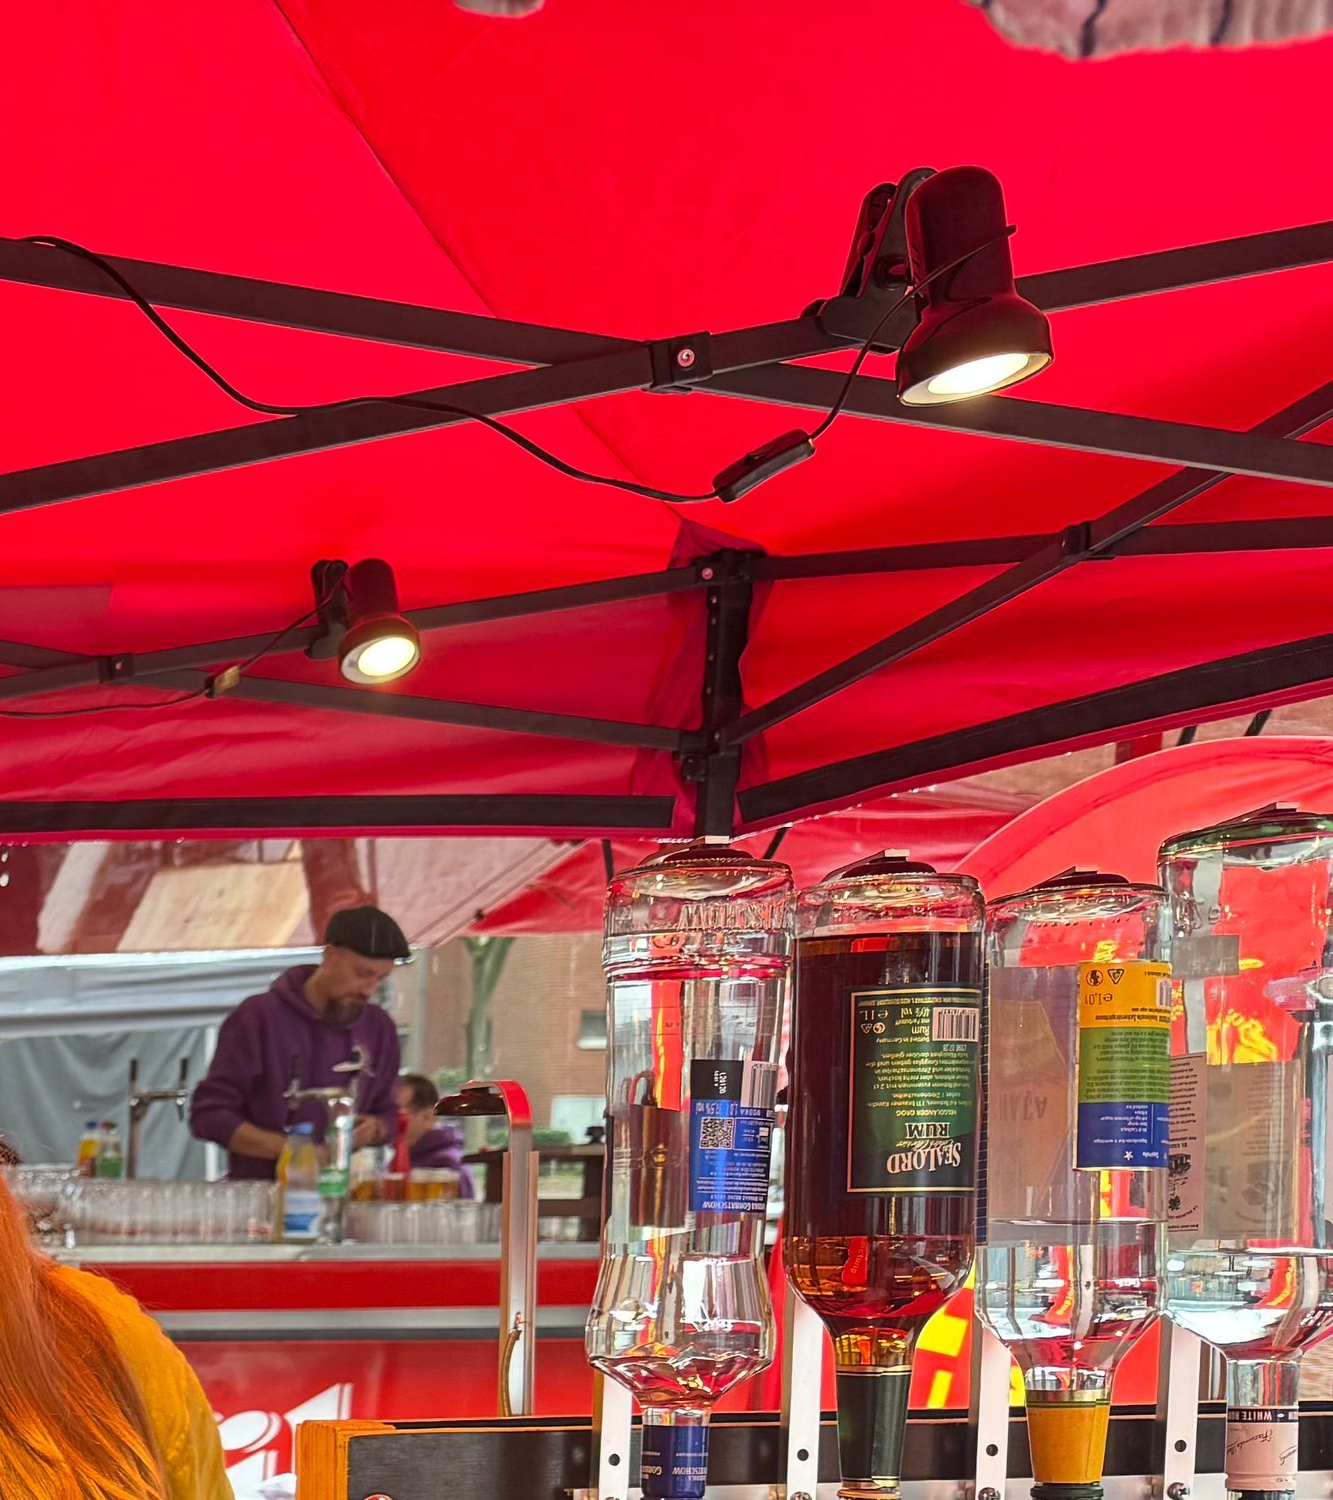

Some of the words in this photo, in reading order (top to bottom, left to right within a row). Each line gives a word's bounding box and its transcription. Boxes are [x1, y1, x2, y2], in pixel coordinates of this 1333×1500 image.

[911, 1025, 930, 1037] Rum
[905, 1122, 950, 1139] RUM
[1240, 1410, 1273, 1421] WHITE
